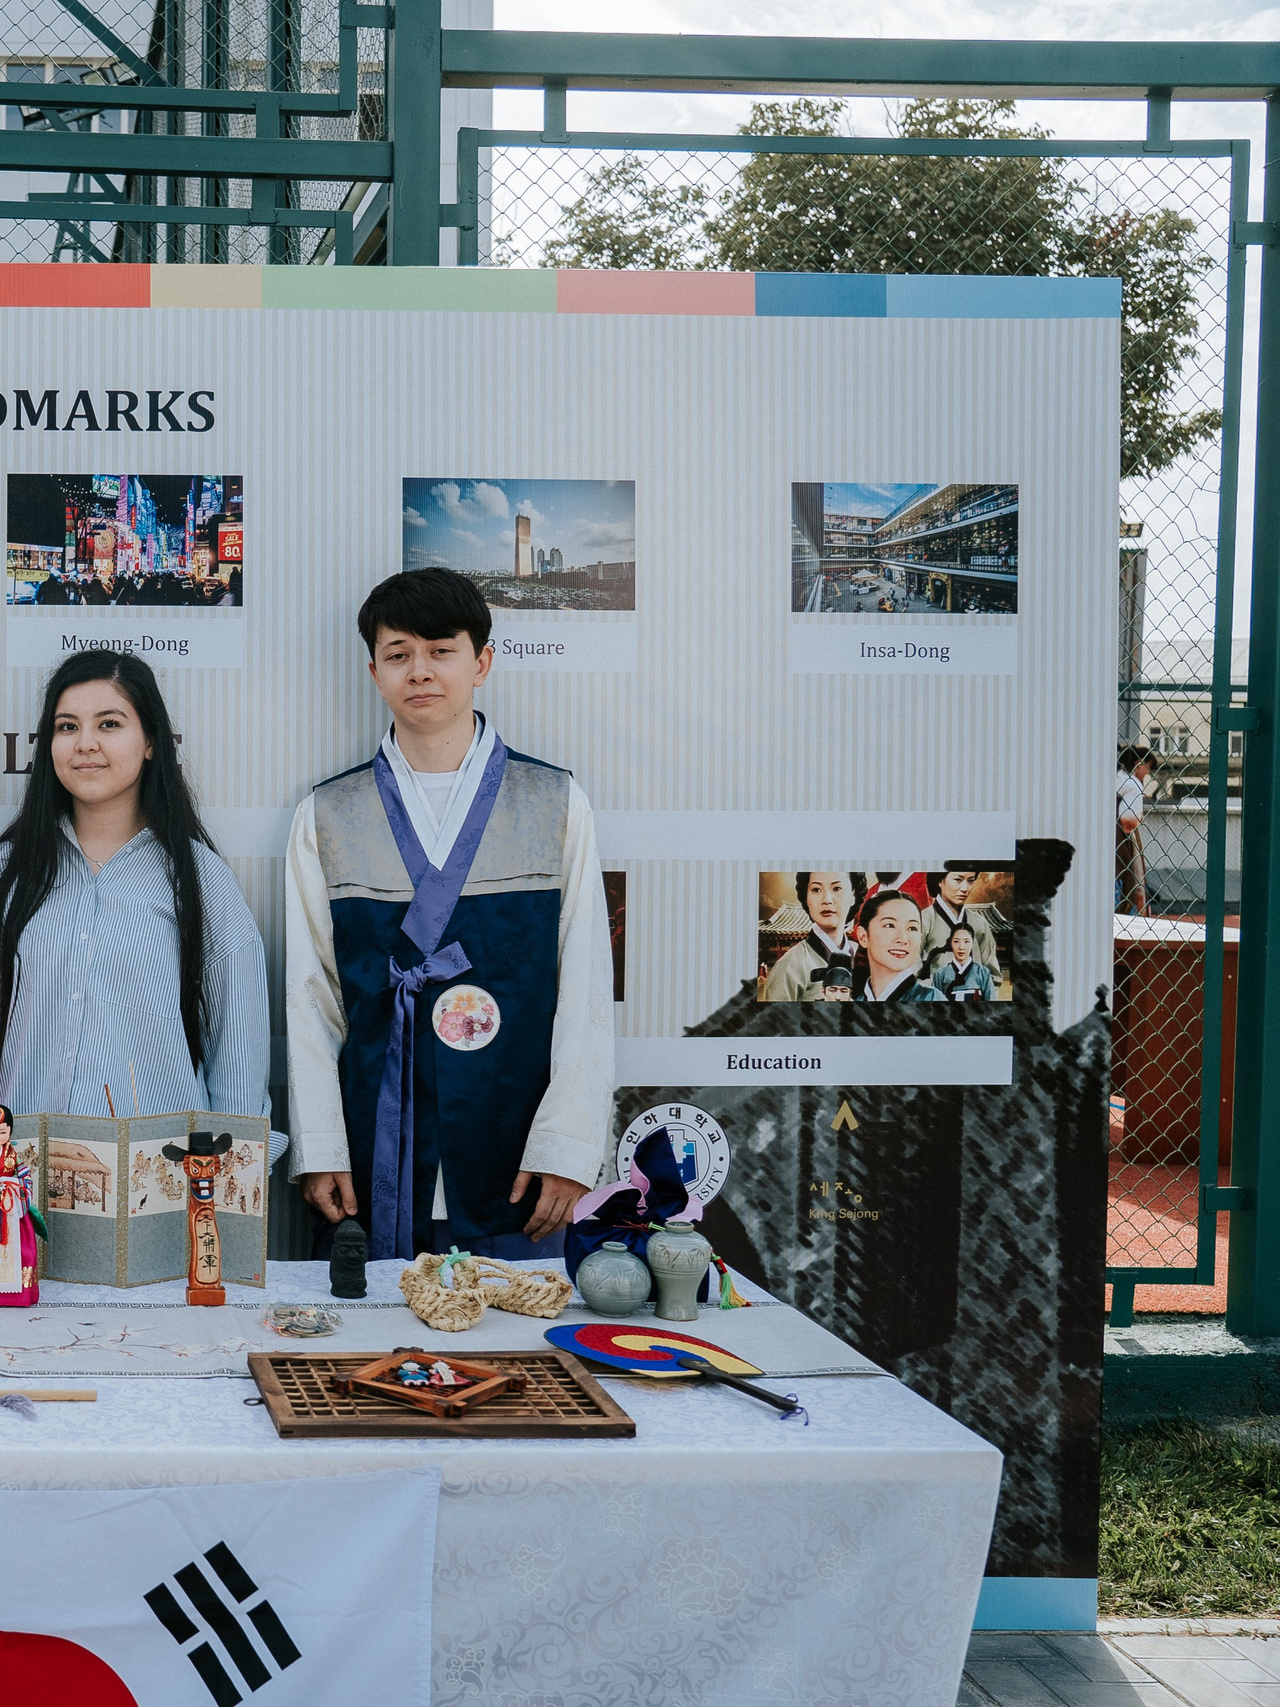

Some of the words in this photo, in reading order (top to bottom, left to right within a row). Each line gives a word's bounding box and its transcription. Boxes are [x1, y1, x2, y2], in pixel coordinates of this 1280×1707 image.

[62, 635, 189, 655] Myeong-Dong
[502, 639, 565, 659] Square
[860, 642, 950, 662] Insa-Dong
[726, 1053, 822, 1070] Education
[626, 1107, 721, 1145] 인하대학교
[809, 1181, 863, 1203] 세종
[809, 1208, 836, 1221] King
[838, 1208, 879, 1221] Sejong
